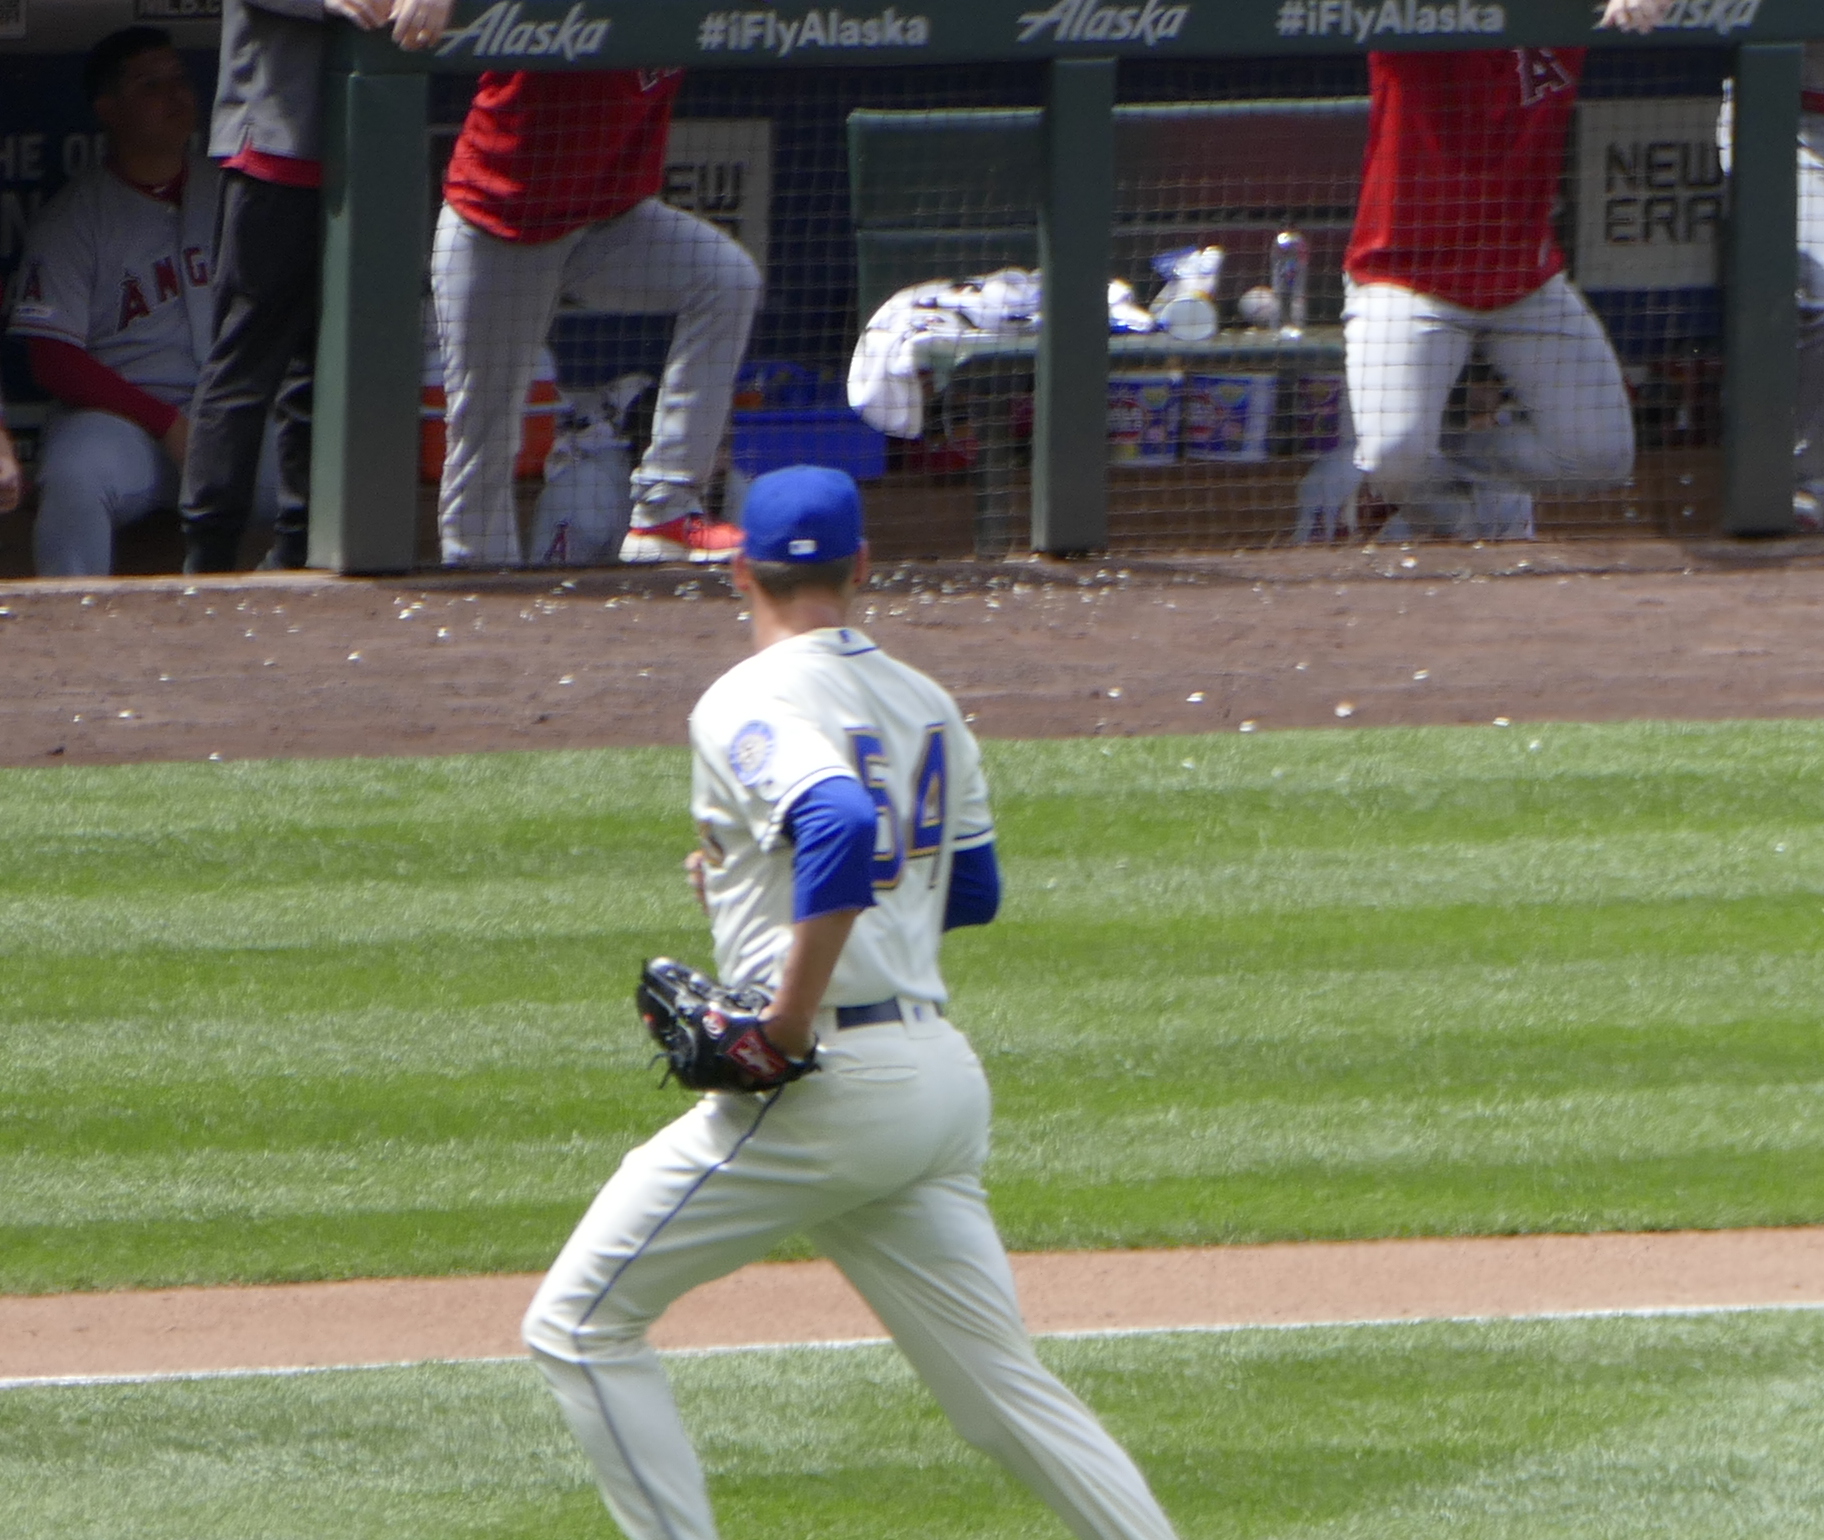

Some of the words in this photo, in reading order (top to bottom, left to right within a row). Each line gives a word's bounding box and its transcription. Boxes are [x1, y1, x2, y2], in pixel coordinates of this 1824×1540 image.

[435, 1, 612, 61] Alaska
[698, 8, 929, 57] #iFlyAlaska
[1016, 0, 1190, 46] Alaska
[1275, 0, 1505, 43] #iFlyAlaska
[661, 160, 750, 211] EW
[1604, 138, 1722, 192] NEW
[116, 246, 210, 332] ANG
[843, 720, 947, 890] 54
